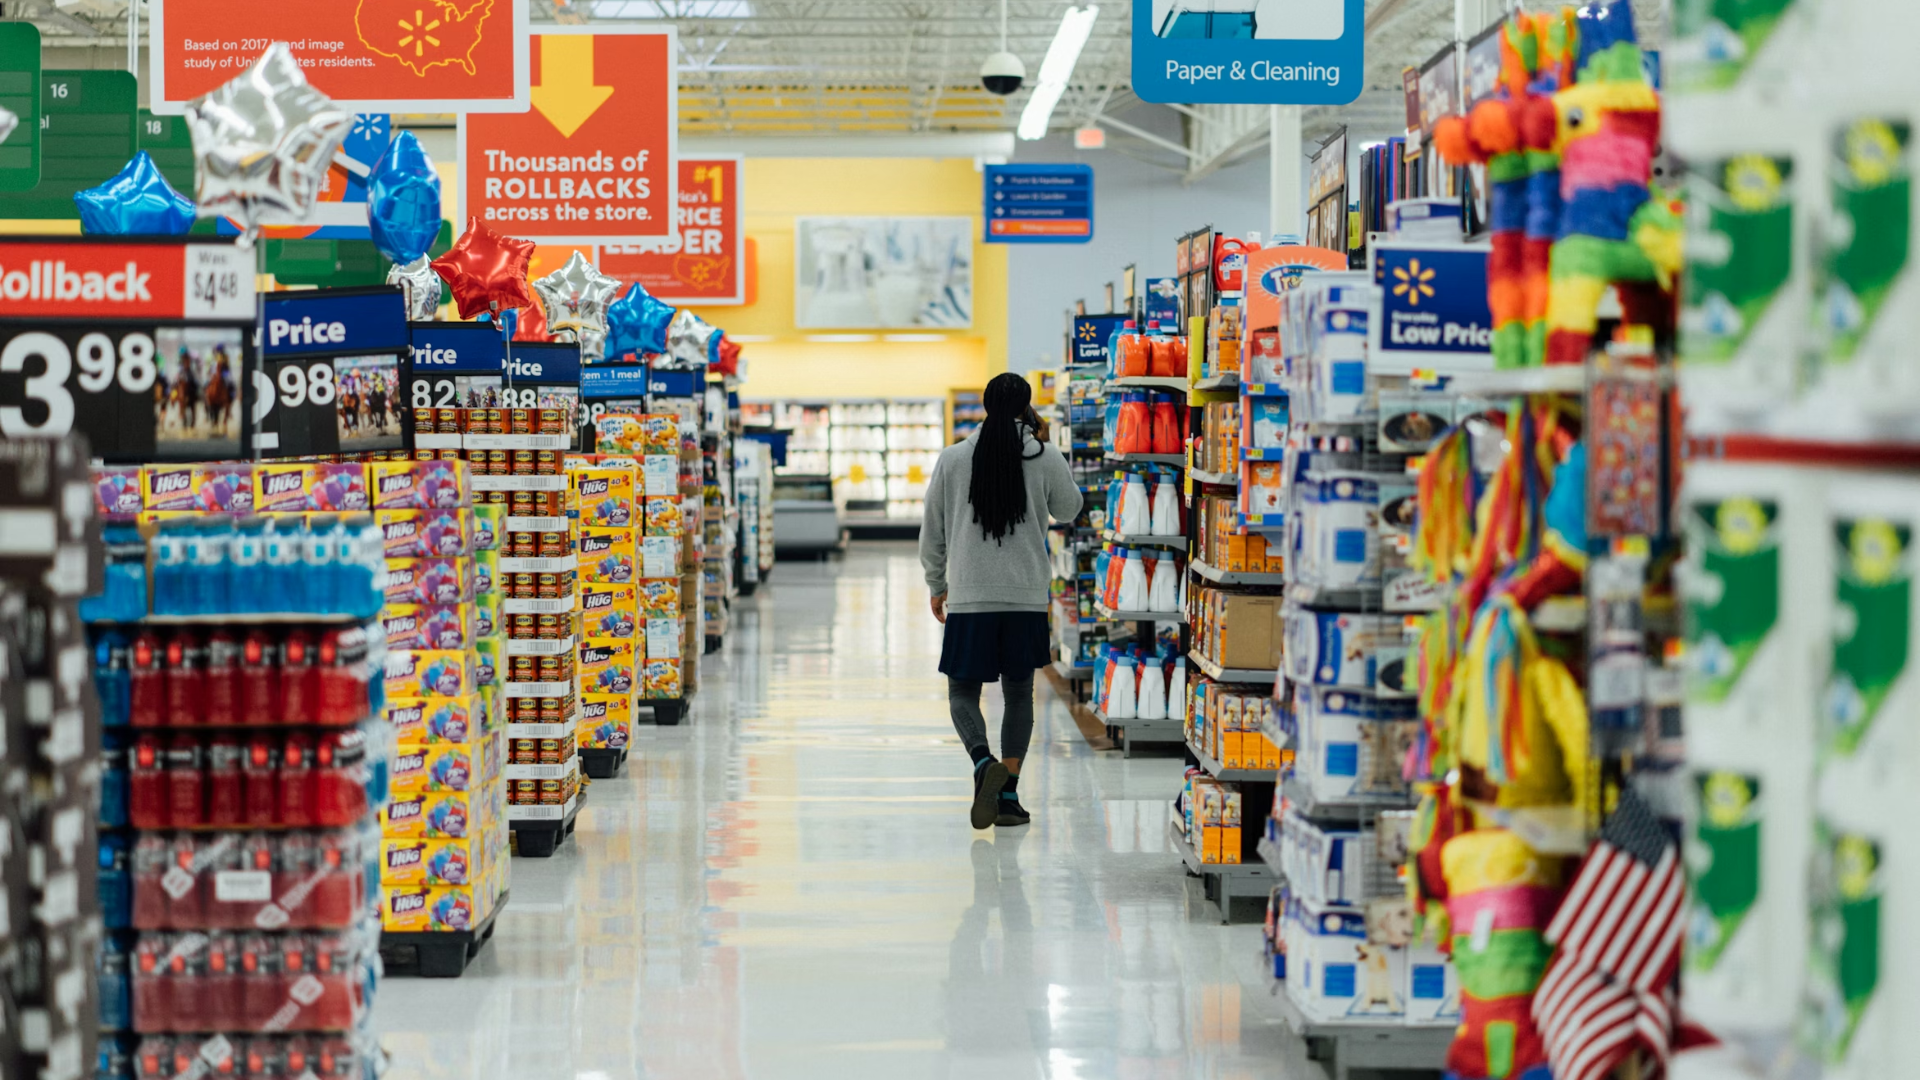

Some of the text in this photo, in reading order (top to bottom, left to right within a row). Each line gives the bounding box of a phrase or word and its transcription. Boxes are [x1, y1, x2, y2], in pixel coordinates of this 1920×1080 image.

[184, 39, 218, 51] Based
[222, 42, 238, 51] on
[241, 39, 268, 51] 2017
[308, 38, 344, 53] image
[184, 57, 216, 70] study
[219, 56, 233, 67] of
[318, 56, 376, 67] residents.
[1166, 60, 1340, 86] Paper & Cleaning
[50, 84, 68, 98] 16
[146, 121, 162, 135] 18
[484, 150, 650, 172] Thousands of
[486, 178, 651, 200] ROLLBACKS
[693, 165, 723, 203] #1
[484, 202, 652, 221] across the store.
[678, 206, 722, 226] RICE
[0, 261, 152, 301] ollback
[270, 316, 346, 346] Price
[1390, 322, 1494, 346] Low Pric
[1080, 348, 1100, 357] Low
[618, 370, 641, 378] meal
[412, 380, 455, 408] 82
[156, 475, 190, 493] HUG
[268, 475, 301, 494] HUG
[384, 474, 411, 492] HUG
[583, 482, 607, 495] HUG
[388, 522, 415, 539] HUG
[587, 595, 611, 608] HUG
[388, 618, 415, 634] HUG
[393, 710, 420, 724] HUG
[395, 757, 422, 772] HUG
[392, 803, 419, 818] HUG
[392, 850, 419, 866] HUG
[395, 896, 423, 911] HUG
